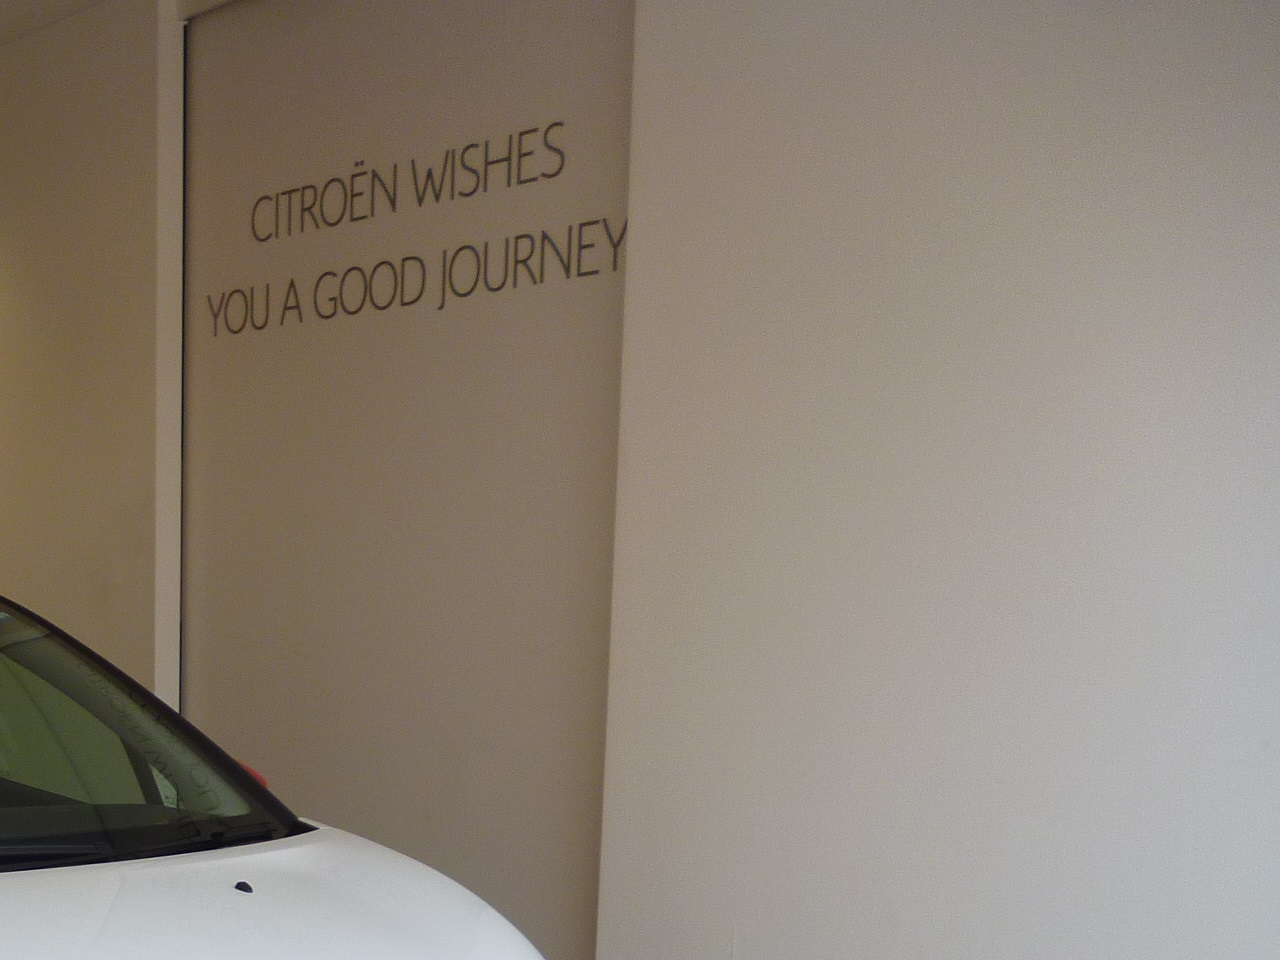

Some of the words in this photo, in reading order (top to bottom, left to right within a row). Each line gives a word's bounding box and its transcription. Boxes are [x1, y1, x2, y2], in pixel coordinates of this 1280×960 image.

[250, 160, 399, 243] CITROËN
[411, 121, 566, 208] WISHES
[206, 282, 270, 337] YOU
[279, 278, 304, 326] A
[313, 256, 427, 320] GOOD
[437, 216, 629, 311] JOURNEY
